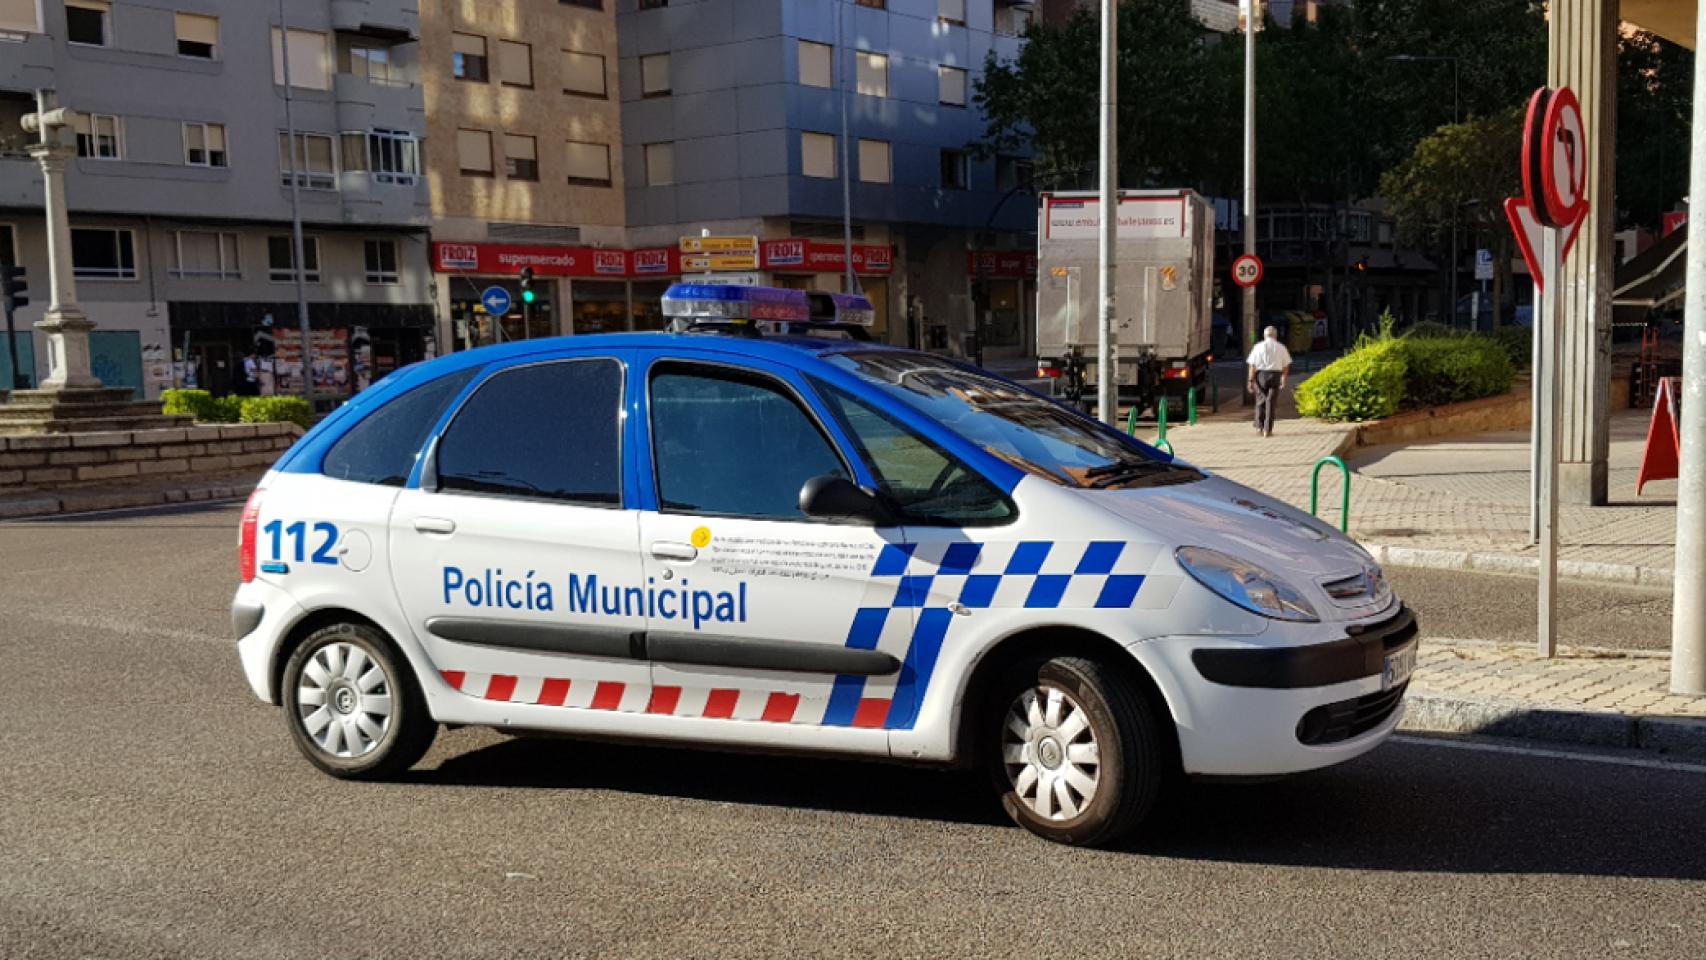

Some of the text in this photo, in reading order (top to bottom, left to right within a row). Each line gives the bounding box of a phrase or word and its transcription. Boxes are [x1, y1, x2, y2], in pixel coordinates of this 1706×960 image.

[441, 246, 666, 267] FROIZ supermercado FROIZ FROIZ
[768, 242, 803, 257] FROIZ
[1238, 265, 1257, 277] 30
[263, 519, 339, 565] 112
[443, 566, 747, 630] Policía Municipal
